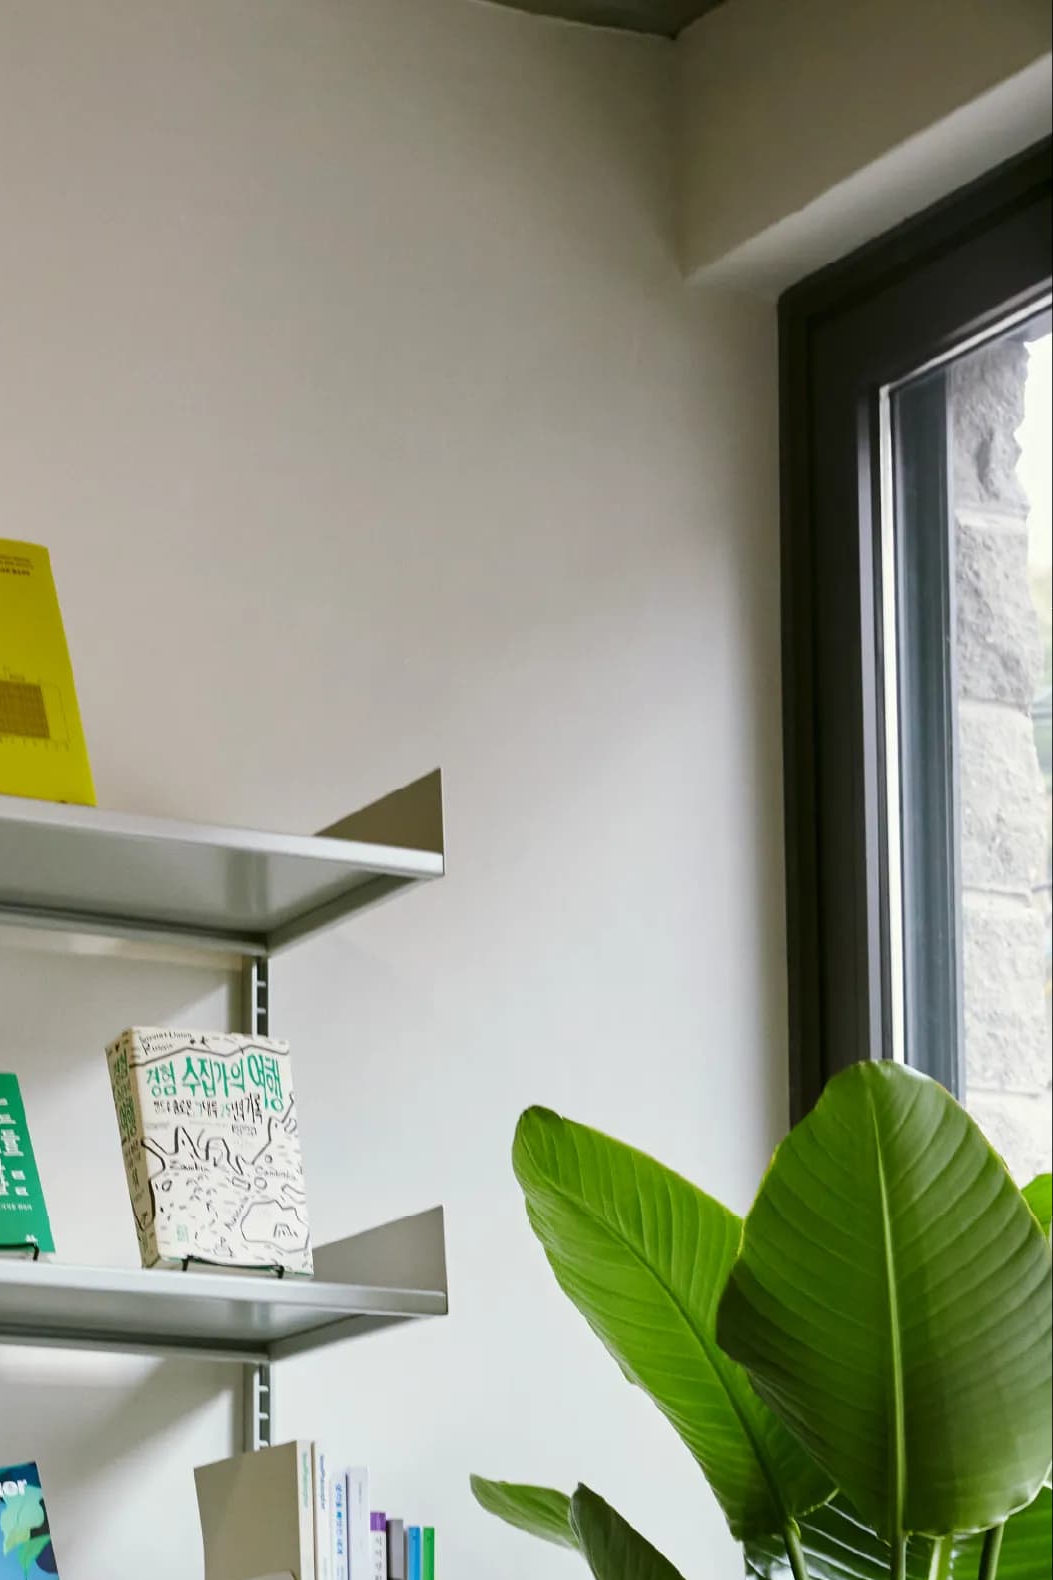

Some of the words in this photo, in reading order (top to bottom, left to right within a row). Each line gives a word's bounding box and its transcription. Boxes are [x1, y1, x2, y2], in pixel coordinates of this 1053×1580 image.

[146, 1061, 177, 1098] 경험
[181, 1056, 246, 1098] 수집가의
[247, 1053, 285, 1112] 여행
